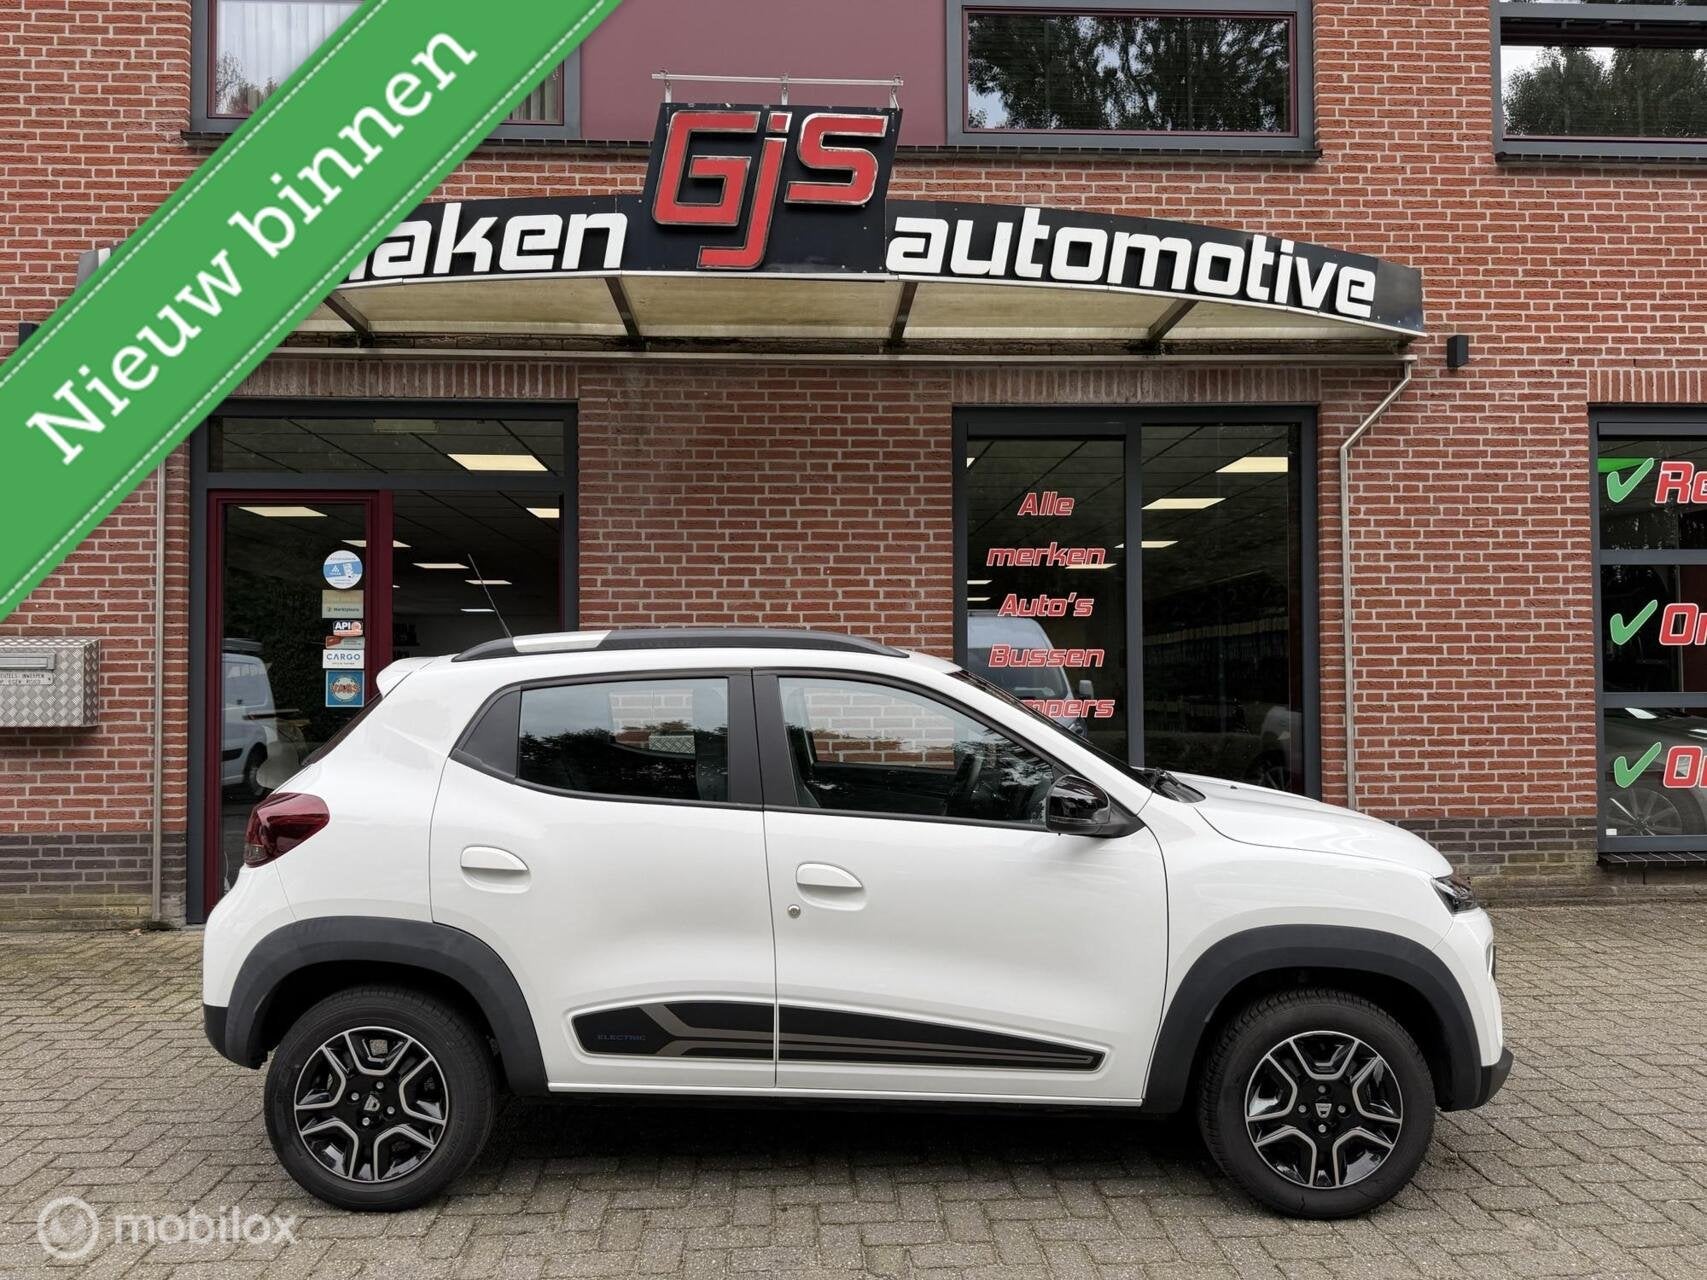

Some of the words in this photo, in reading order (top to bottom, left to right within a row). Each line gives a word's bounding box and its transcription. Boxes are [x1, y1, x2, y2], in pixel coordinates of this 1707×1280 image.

[349, 202, 629, 280] aken
[885, 206, 1376, 319] automotive
[1017, 491, 1075, 516] Alle
[986, 542, 1106, 567] merken
[998, 592, 1095, 617] Auto's
[335, 621, 351, 630] API
[326, 653, 361, 661] CARGO
[988, 644, 1105, 668] Bussen
[1663, 745, 1707, 788] O
